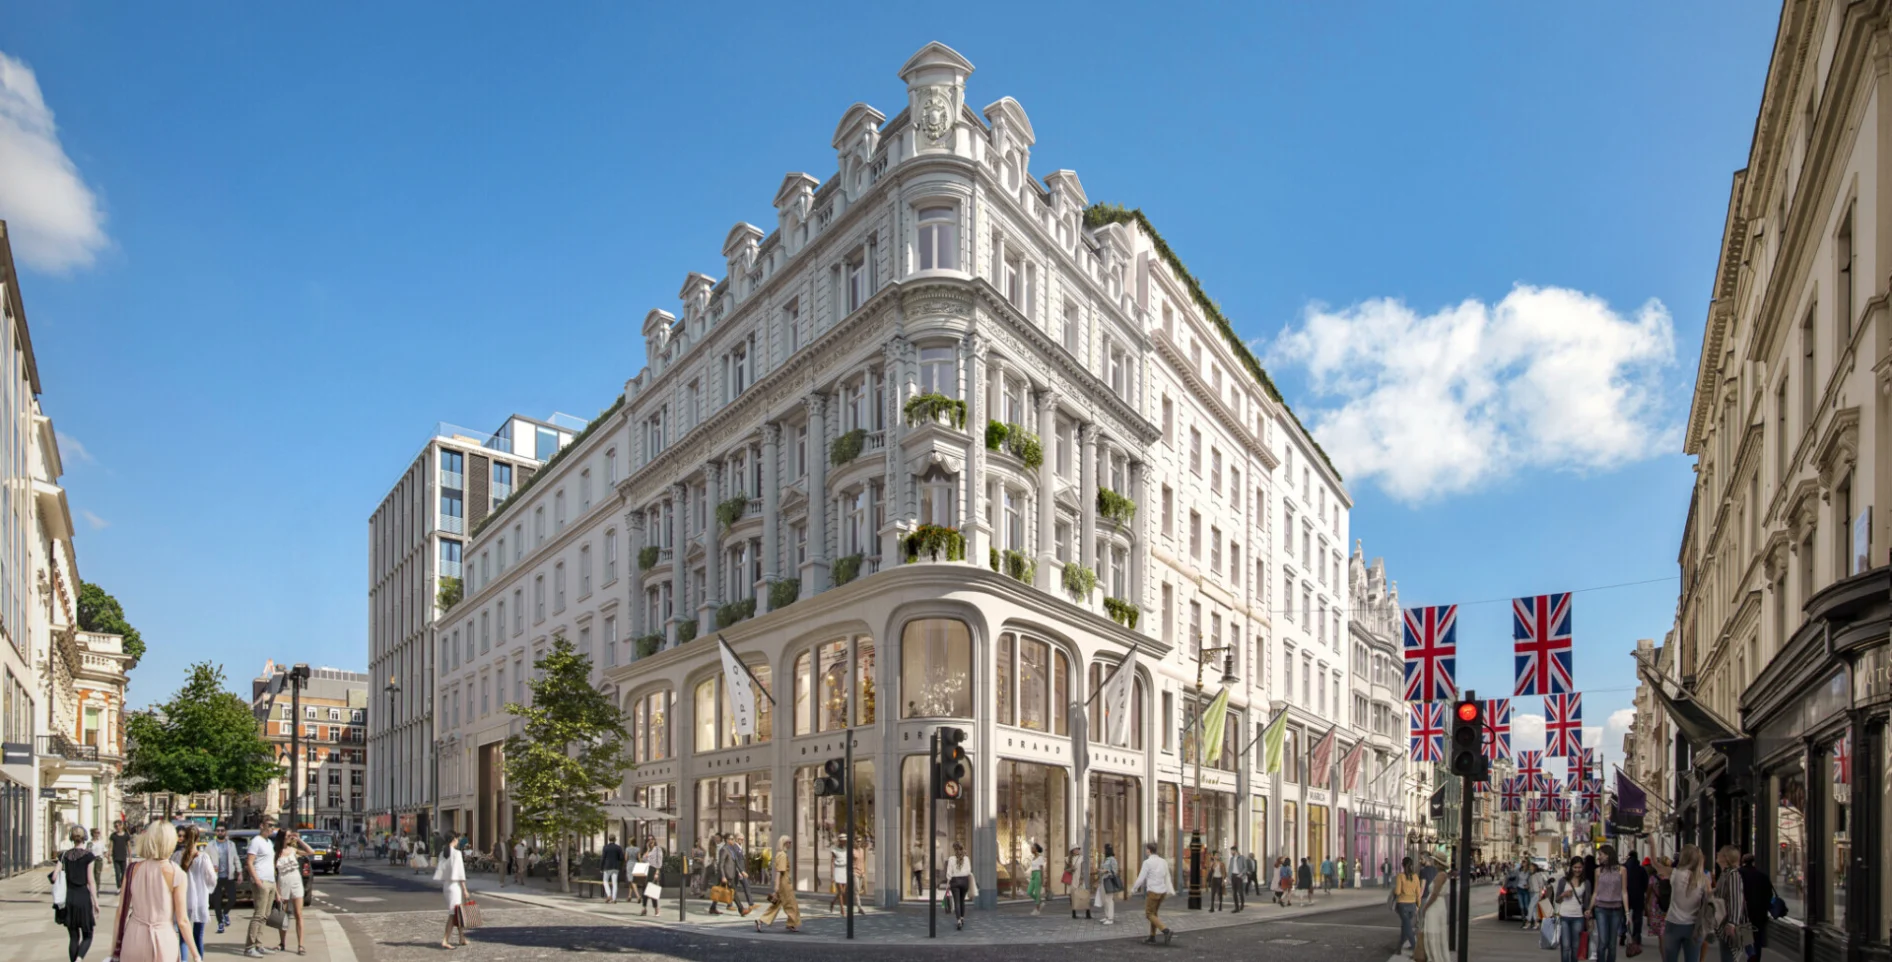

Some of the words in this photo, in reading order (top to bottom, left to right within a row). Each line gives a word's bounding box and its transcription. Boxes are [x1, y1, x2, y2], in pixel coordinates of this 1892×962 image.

[903, 731, 968, 741] BRD
[802, 739, 858, 755] BRAND
[1008, 738, 1061, 754] BRAND
[707, 755, 750, 768] BRAND
[1095, 753, 1135, 766] BRAND
